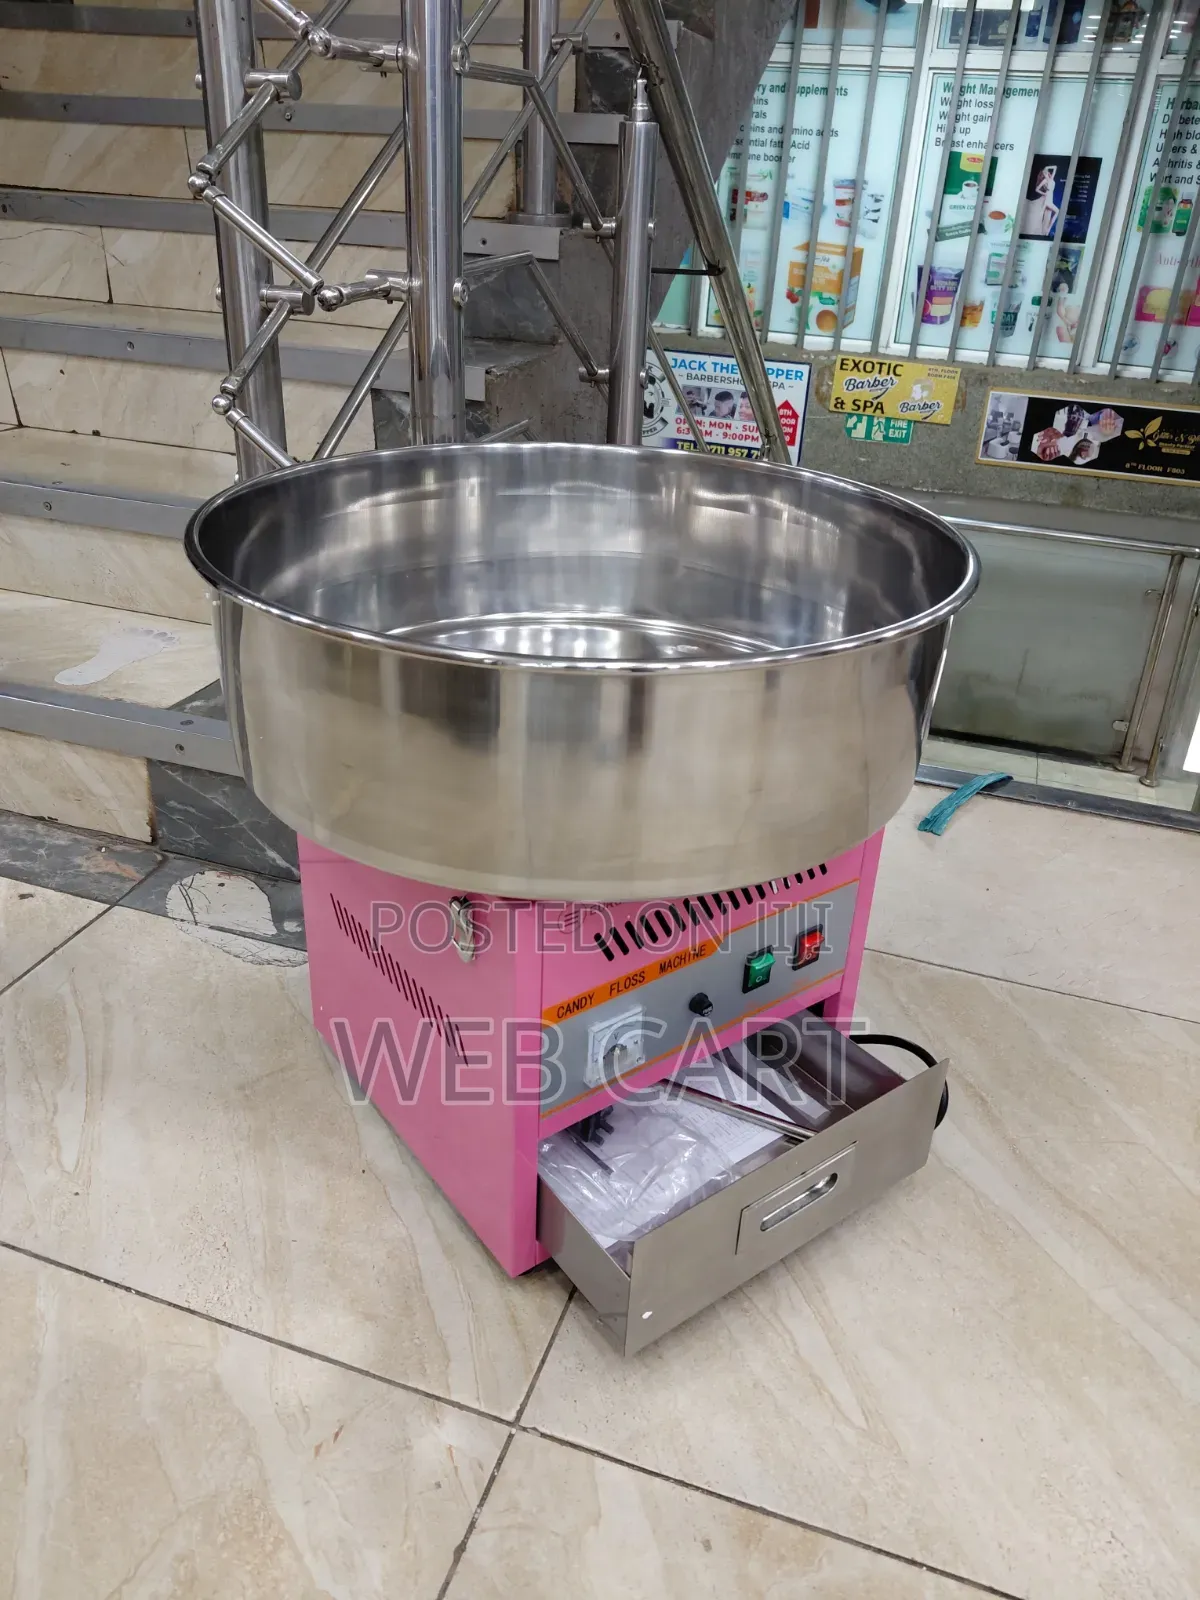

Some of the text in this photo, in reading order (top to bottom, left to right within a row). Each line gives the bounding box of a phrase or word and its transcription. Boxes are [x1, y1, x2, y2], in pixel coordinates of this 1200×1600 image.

[769, 82, 786, 93] and
[795, 84, 848, 97] upplemnts
[943, 82, 1040, 98] Wght Magemen
[941, 97, 994, 110] Wght loss
[1166, 97, 1200, 110] Hrba
[939, 111, 970, 123] Wght
[768, 126, 784, 134] and
[791, 127, 813, 136] mino
[816, 128, 839, 137] acds
[936, 124, 971, 136] His up
[770, 138, 784, 148] fatt
[791, 140, 810, 150] Acid
[935, 137, 1014, 151] Brast enhacers
[1156, 143, 1187, 154] Uers
[1152, 157, 1193, 169] Ahritis
[1174, 175, 1194, 184] and
[671, 357, 804, 381] JACK THE PPER
[839, 358, 904, 377] EXOTIC
[686, 373, 786, 391] BARBERSHO PA
[844, 376, 897, 396] Barber
[833, 396, 885, 414] & SPA
[899, 400, 942, 415] Barber
[675, 417, 706, 428] OPN:
[708, 420, 732, 430] MON
[722, 431, 760, 443] 9:00PM
[888, 428, 907, 438] EXIT
[727, 448, 749, 459] 957
[556, 944, 707, 1019] CANDY FLOSS MACHINE
